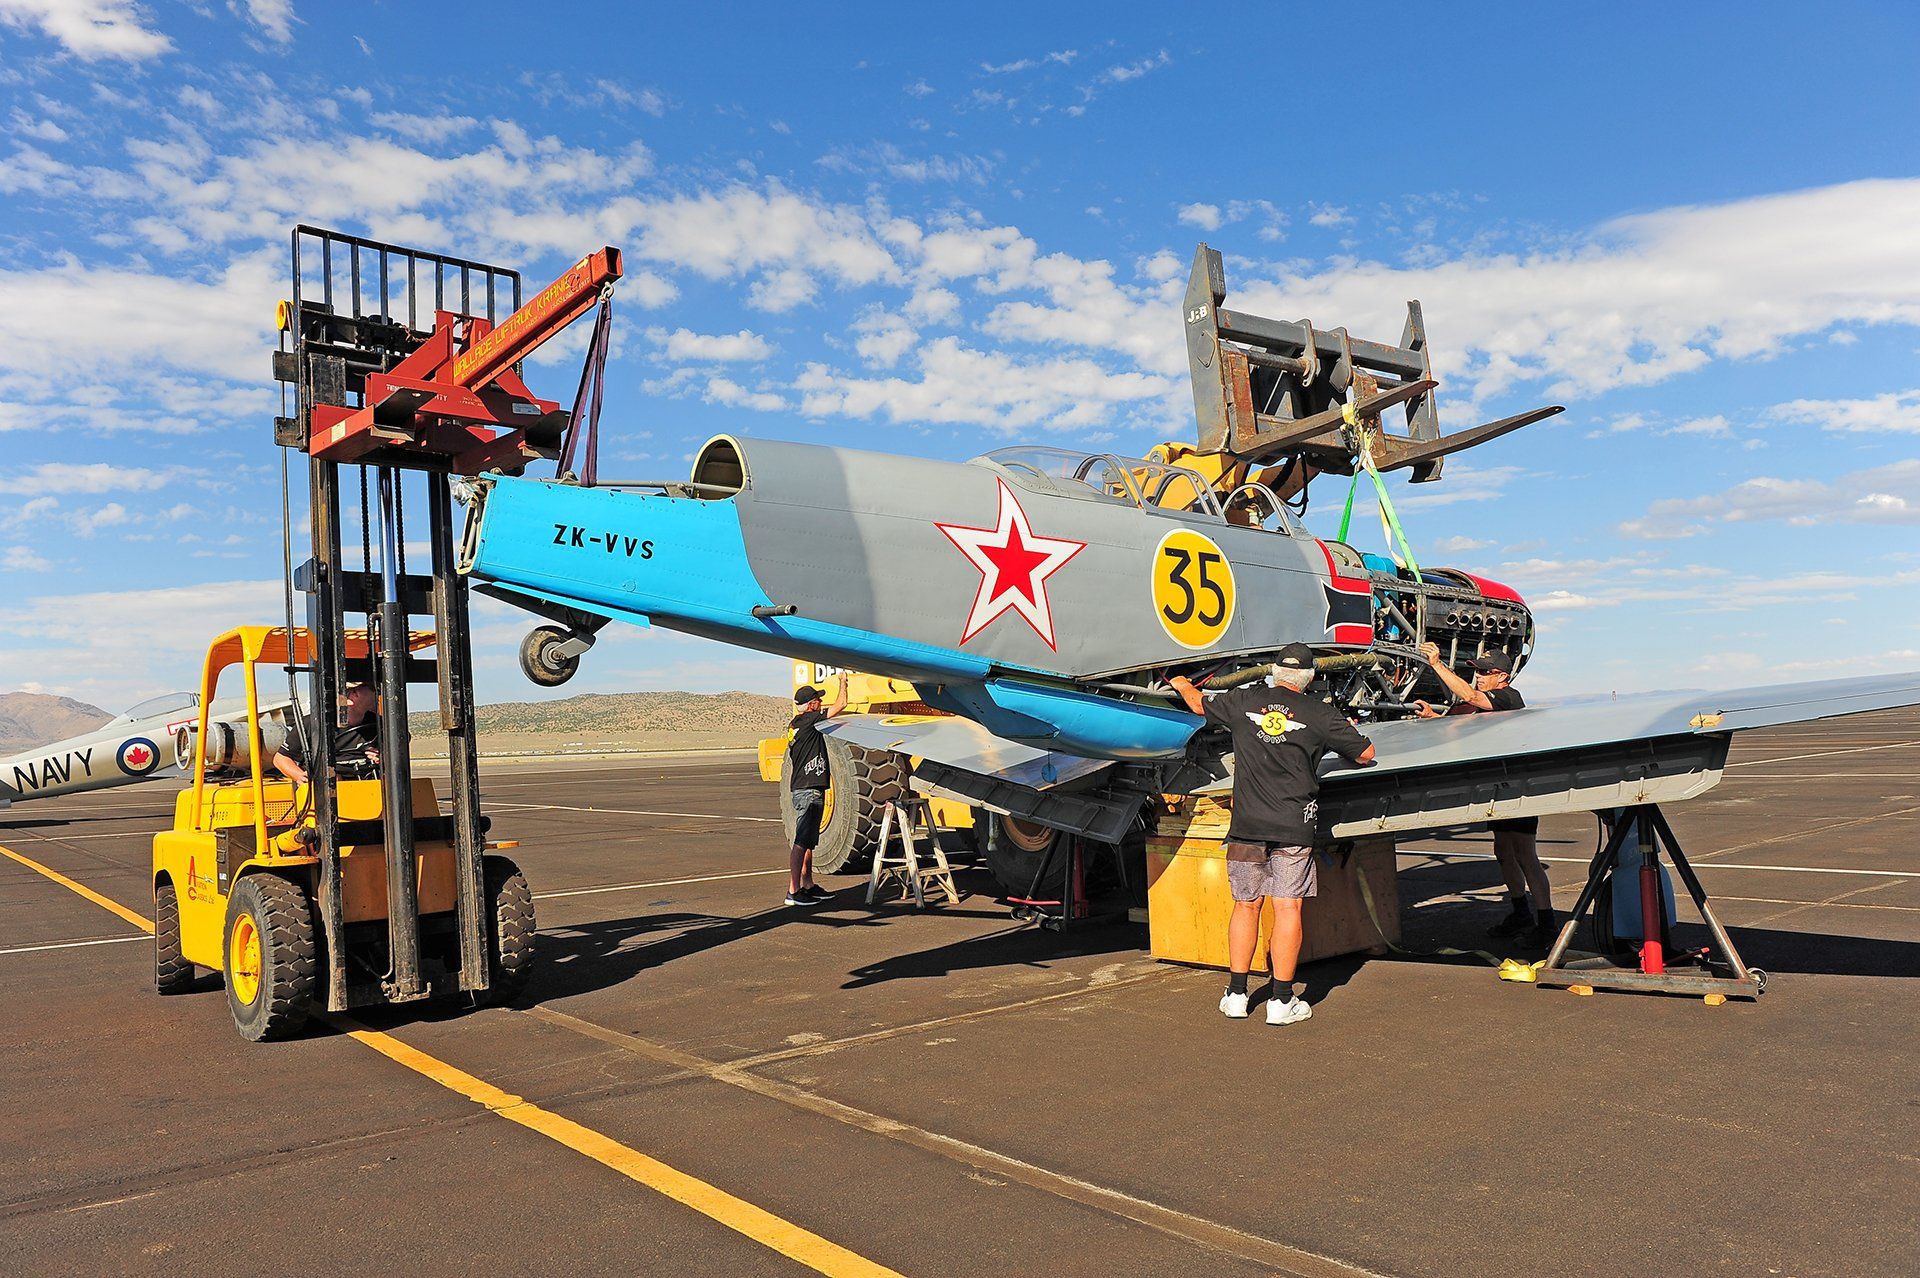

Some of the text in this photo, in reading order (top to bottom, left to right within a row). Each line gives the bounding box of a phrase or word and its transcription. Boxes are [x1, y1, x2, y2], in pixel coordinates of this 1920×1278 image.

[454, 337, 492, 376] WALLACE
[494, 308, 533, 344] LIFTRUK
[553, 524, 654, 560] ZK-VVS
[1163, 547, 1226, 627] 35
[1256, 729, 1287, 743] NOISE
[1265, 716, 1283, 730] 35
[13, 747, 93, 794] NAVY
